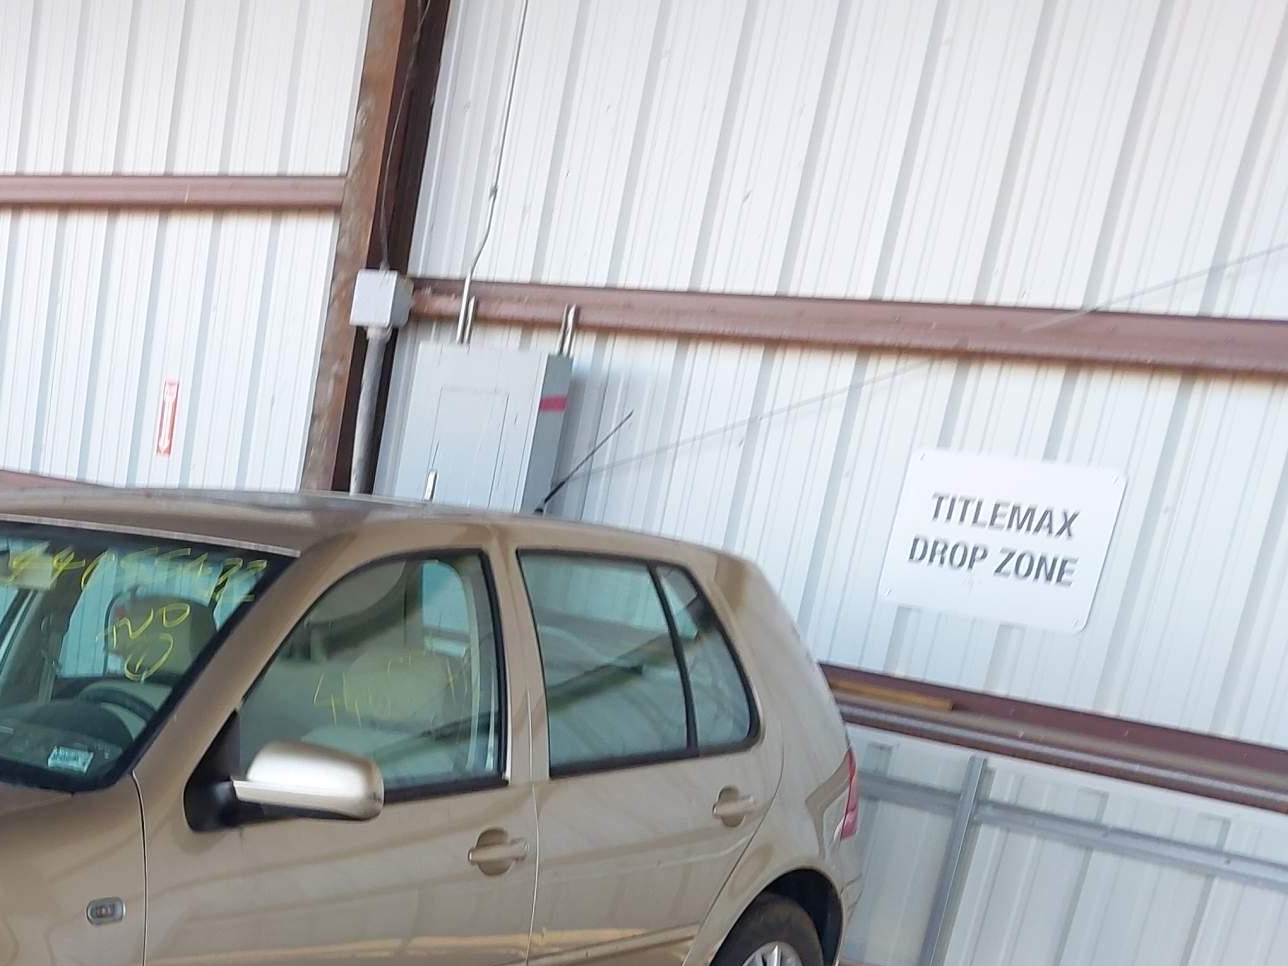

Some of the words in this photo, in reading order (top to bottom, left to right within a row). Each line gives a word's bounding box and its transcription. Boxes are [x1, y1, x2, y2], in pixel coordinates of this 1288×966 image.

[931, 493, 1080, 540] TITLEMAX
[908, 535, 988, 572] DROP
[993, 547, 1078, 587] ZONE
